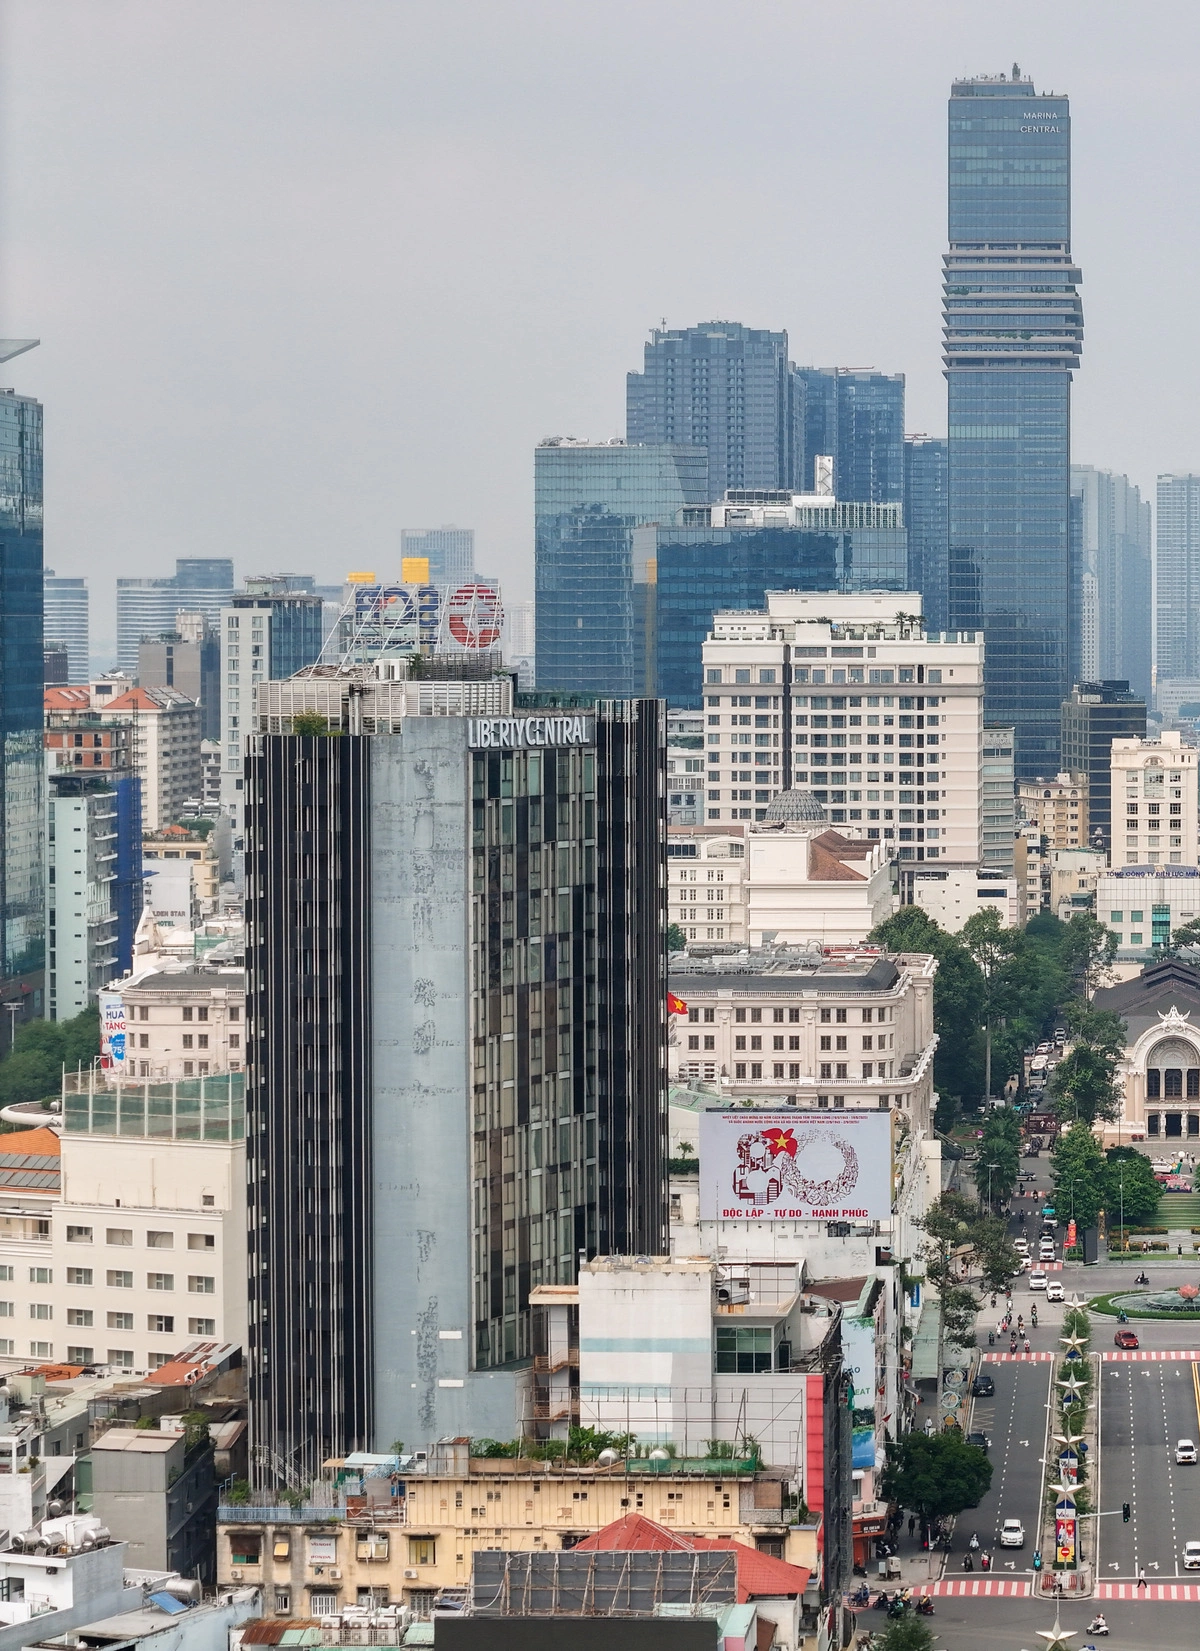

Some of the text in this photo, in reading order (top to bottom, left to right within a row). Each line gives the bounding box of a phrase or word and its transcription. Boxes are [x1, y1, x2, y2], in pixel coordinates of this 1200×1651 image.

[1023, 112, 1058, 120] MARINA
[1020, 125, 1061, 133] CENTRAL
[723, 1208, 743, 1219] ĐỘC
[745, 1208, 764, 1220] LẬP
[773, 1208, 787, 1219] TỰ
[790, 1209, 802, 1218] DO
[812, 1209, 839, 1220] HẠNH
[842, 1207, 868, 1218] PHÚC
